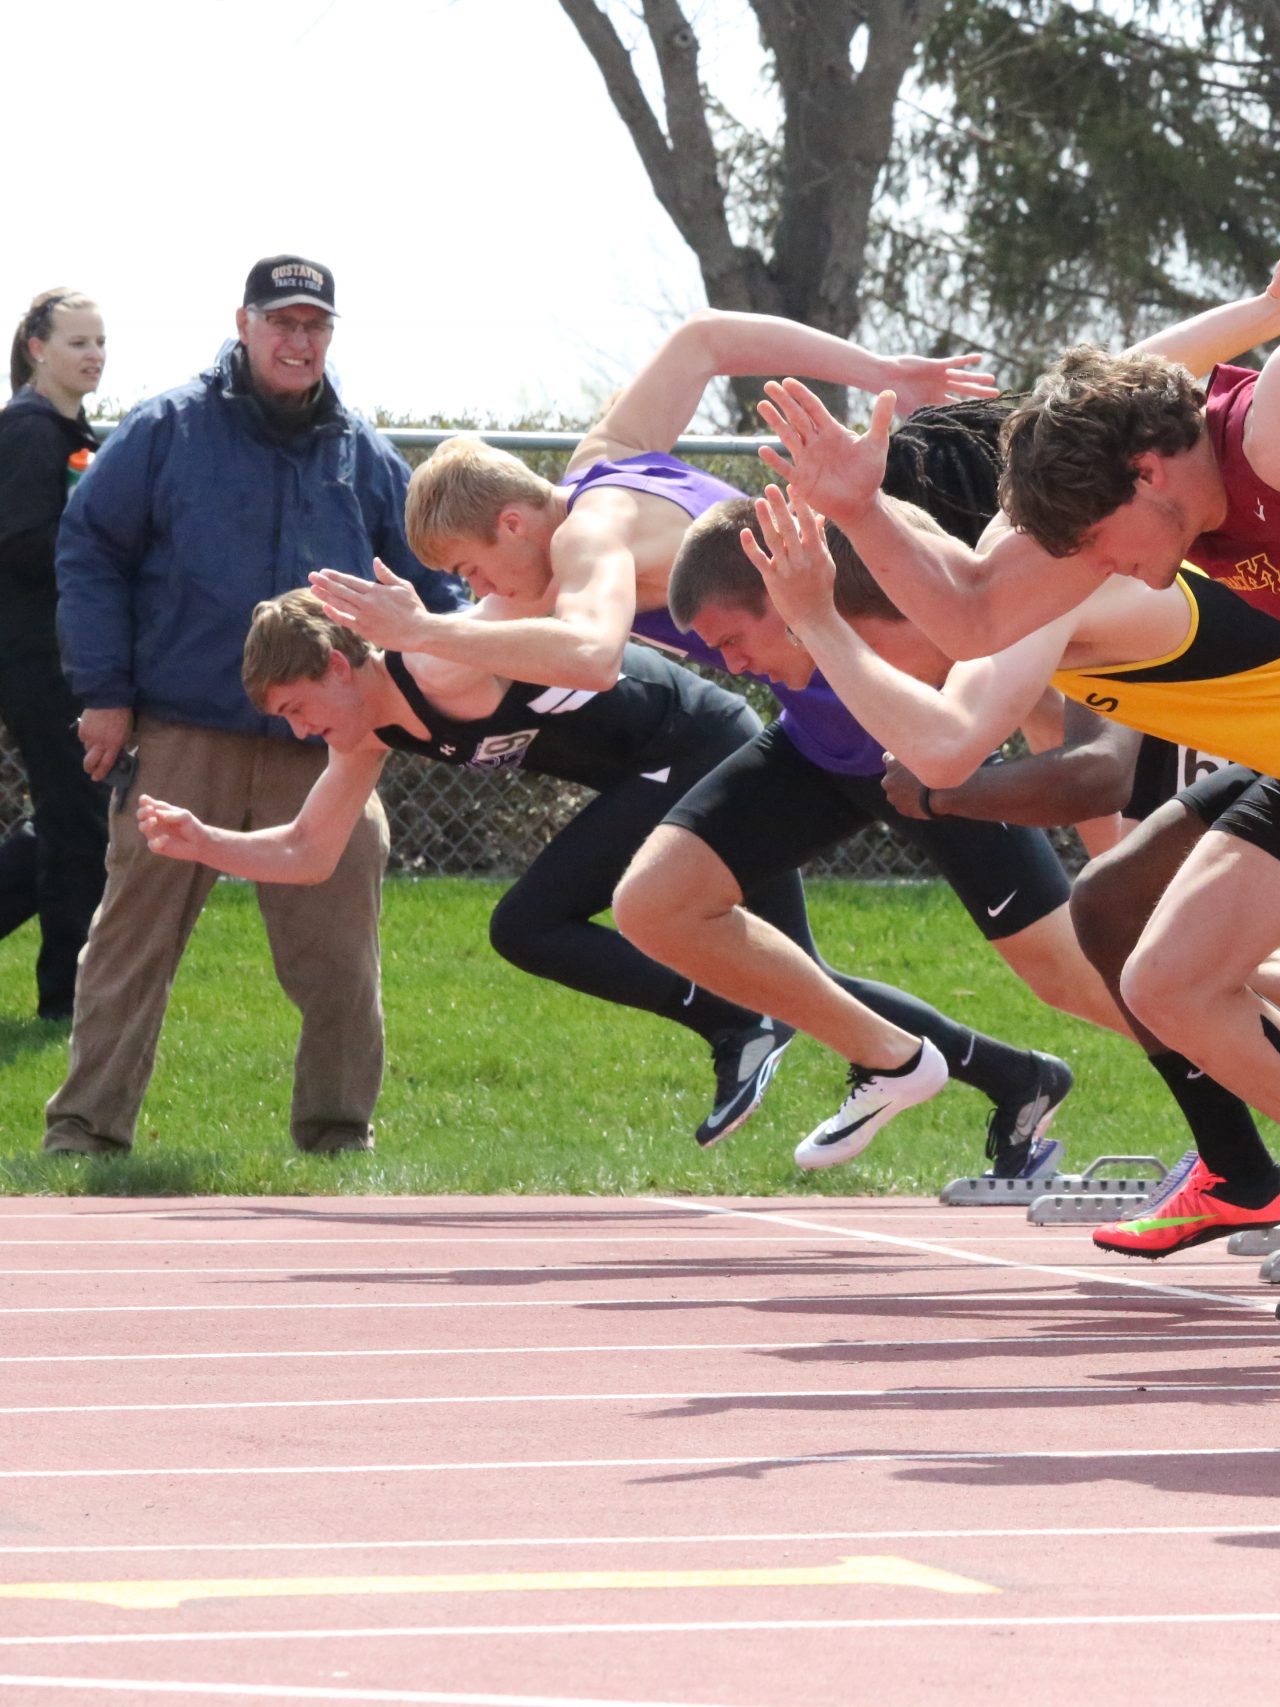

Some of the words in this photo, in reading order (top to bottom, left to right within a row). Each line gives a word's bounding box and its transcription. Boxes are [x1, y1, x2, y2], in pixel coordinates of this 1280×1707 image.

[271, 264, 324, 285] GUSTAVUS
[275, 279, 297, 288] TRACK
[304, 281, 322, 292] FIELD
